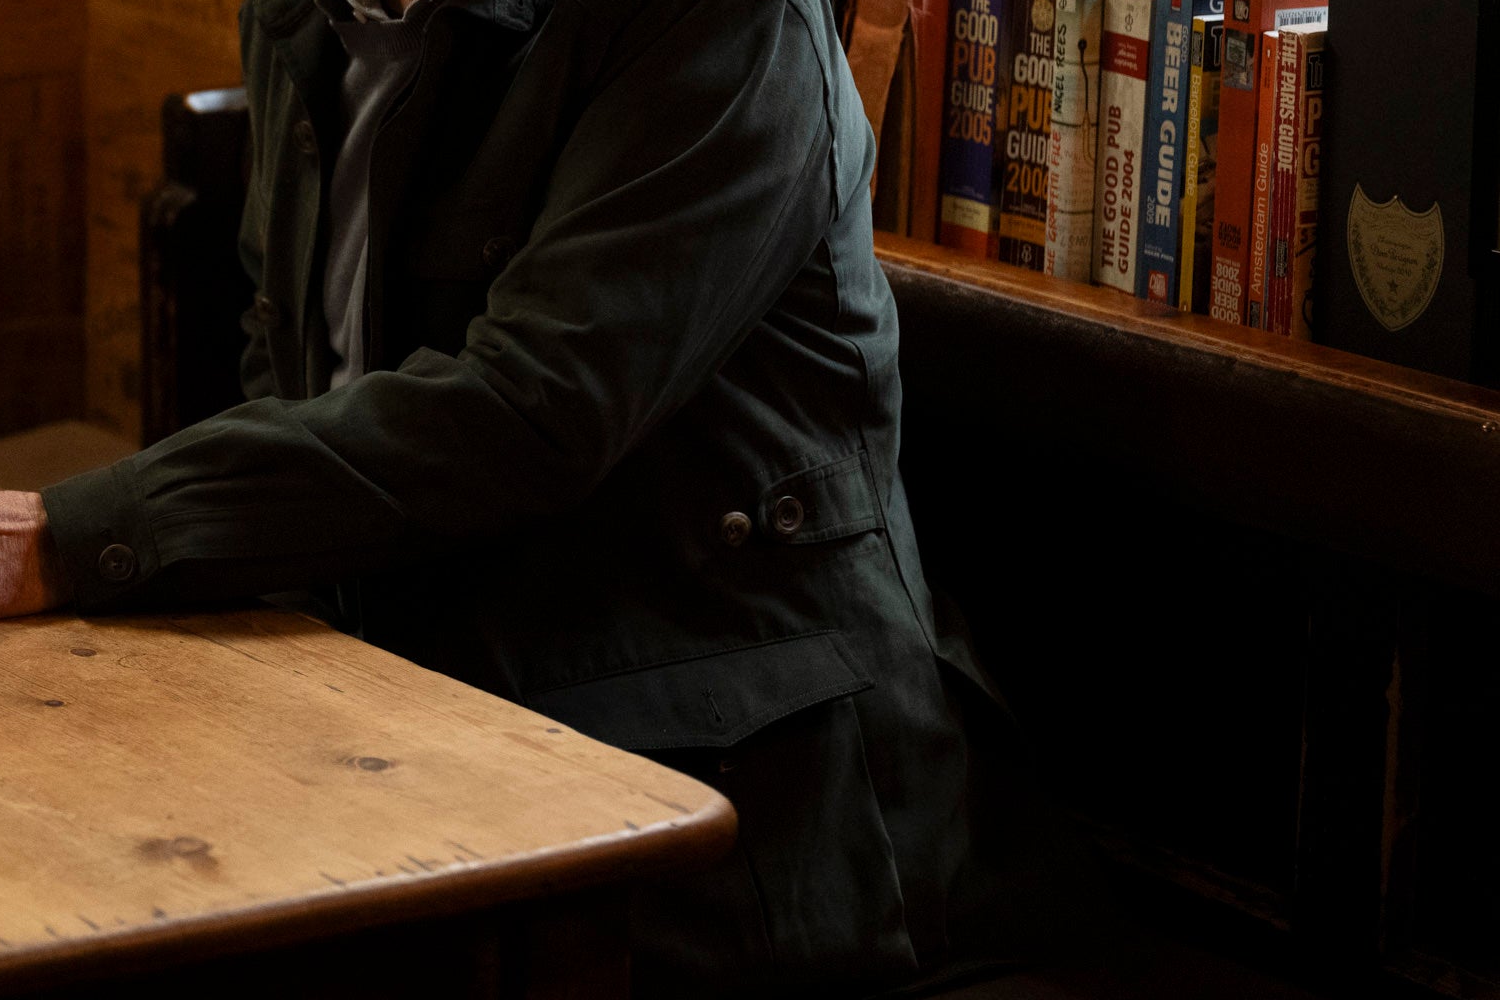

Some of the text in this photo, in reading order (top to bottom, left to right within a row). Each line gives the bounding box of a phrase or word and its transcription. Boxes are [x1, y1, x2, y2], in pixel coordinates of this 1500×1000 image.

[955, 7, 998, 46] GOOD
[1030, 32, 1052, 57] THE
[953, 40, 997, 88] PUB
[1053, 23, 1067, 115] NIGEL REES
[951, 79, 995, 116] GUIDE
[1277, 30, 1297, 175] THE PARIS GUIDE
[950, 108, 993, 148] 2005
[1154, 20, 1183, 229] BEER GUIDE
[1186, 74, 1201, 197] Barcelona Guide
[1051, 129, 1061, 167] FILE
[1101, 104, 1122, 268] THE GOOD PUB
[1118, 149, 1135, 275] GUIDE 2004
[1251, 142, 1269, 294] Amsterdam Guide
[1212, 275, 1242, 297] GUIDE
[1215, 263, 1240, 281] 2008
[1211, 305, 1241, 325] GOOD
[1213, 292, 1239, 311] BEER
